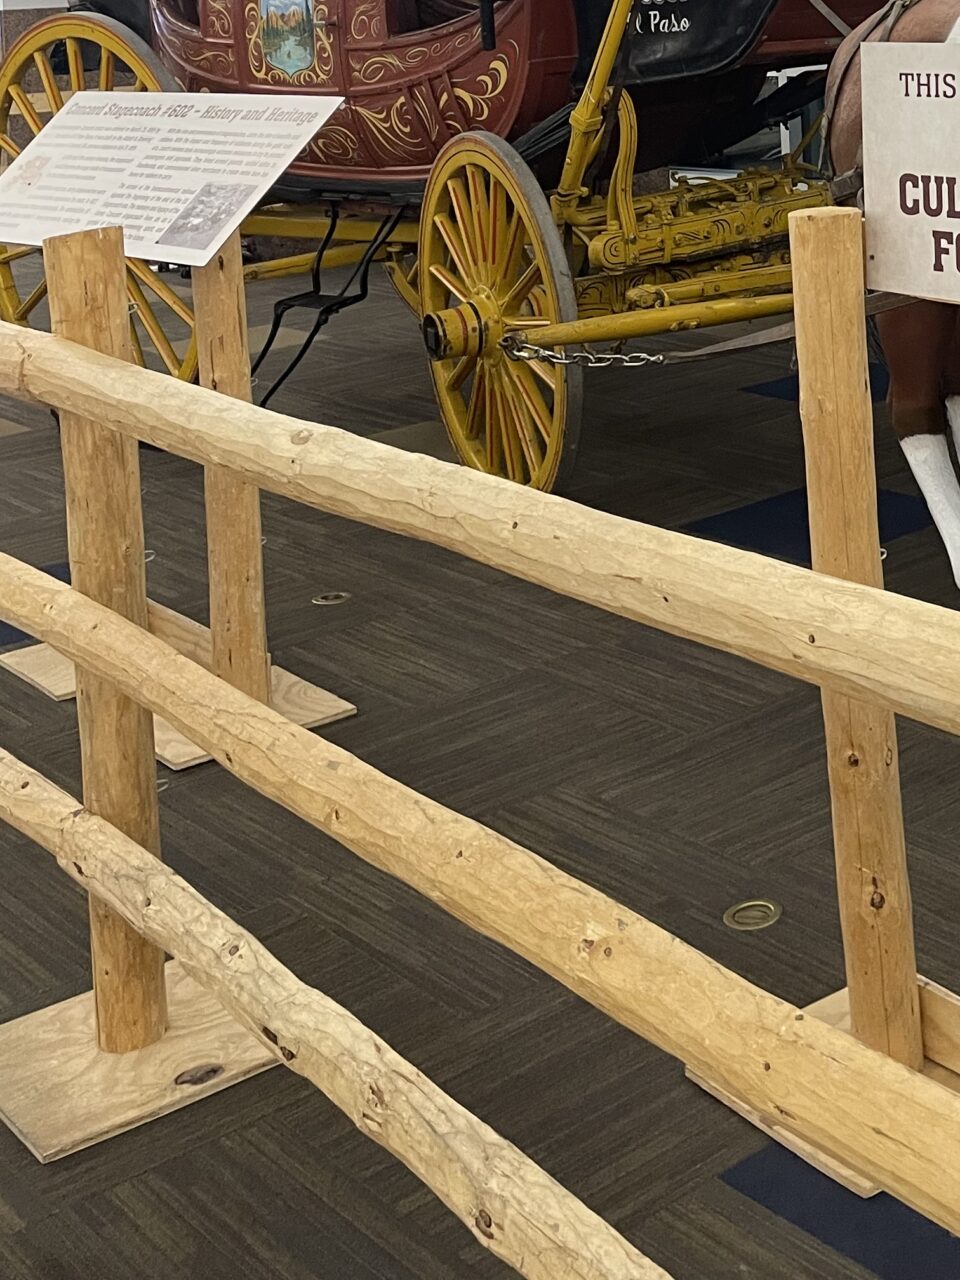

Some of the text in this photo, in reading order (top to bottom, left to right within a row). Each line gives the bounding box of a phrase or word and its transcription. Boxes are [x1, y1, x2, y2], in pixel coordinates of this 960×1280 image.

[648, 10, 690, 33] Paso
[898, 72, 957, 99] THIS
[103, 102, 162, 119] Stagecoach
[162, 104, 195, 118] #602
[200, 105, 243, 122] History
[240, 107, 269, 121] and
[264, 108, 319, 126] Heritage
